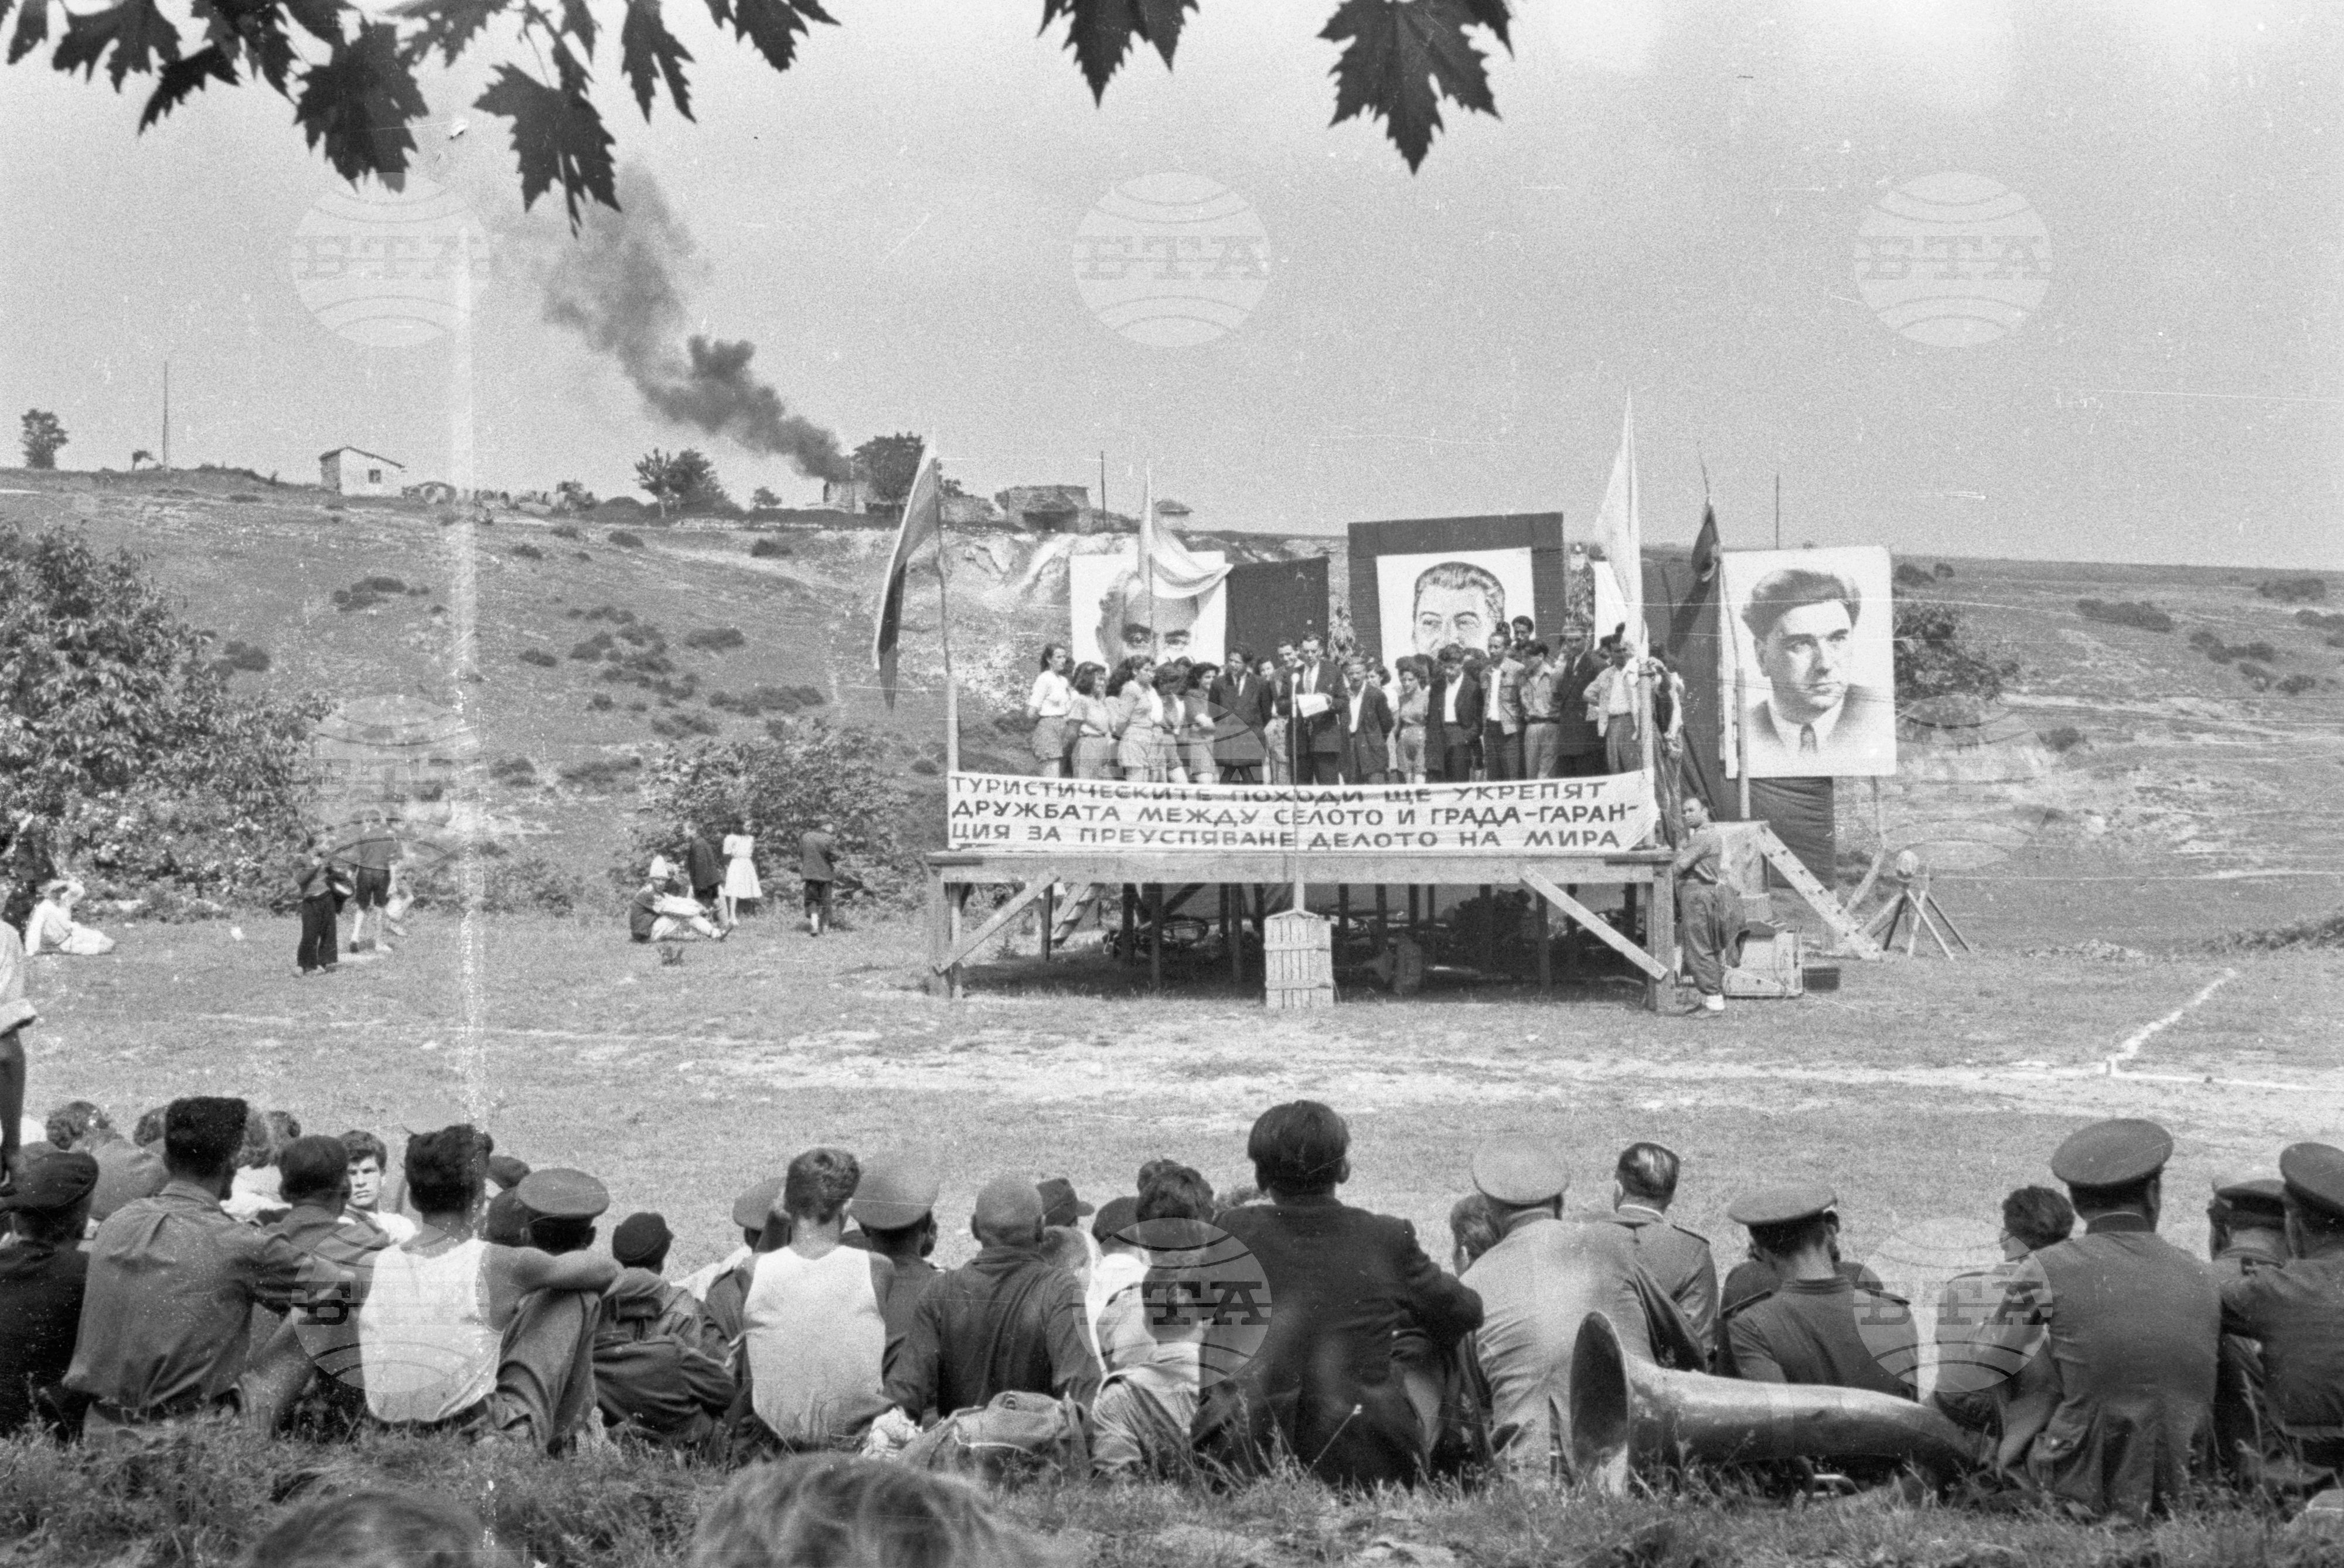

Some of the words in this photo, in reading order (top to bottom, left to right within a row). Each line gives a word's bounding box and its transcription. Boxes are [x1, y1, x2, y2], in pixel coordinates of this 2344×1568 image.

[950, 776, 1212, 801] ТУРИСТИЧЕСКИТЕ
[1232, 790, 1364, 806] ПОХОДИ
[1384, 789, 1432, 805] ЩЕ
[1453, 781, 1607, 801] УКРЕПЯТ
[951, 800, 1120, 822] ДРУЖБАТА
[1137, 806, 1259, 827] МЕЖДУ
[1273, 809, 1383, 825] СЕЛОТО
[1398, 809, 1415, 825] И
[951, 823, 1010, 840] ЦИЯ
[1027, 825, 1061, 842] ЗА
[1079, 827, 1295, 847] ПРЕУСПЯВАНЕ
[1307, 831, 1438, 851] ДЕЛОТО
[1459, 831, 1501, 847] НА
[1524, 830, 1620, 848] МИРА
